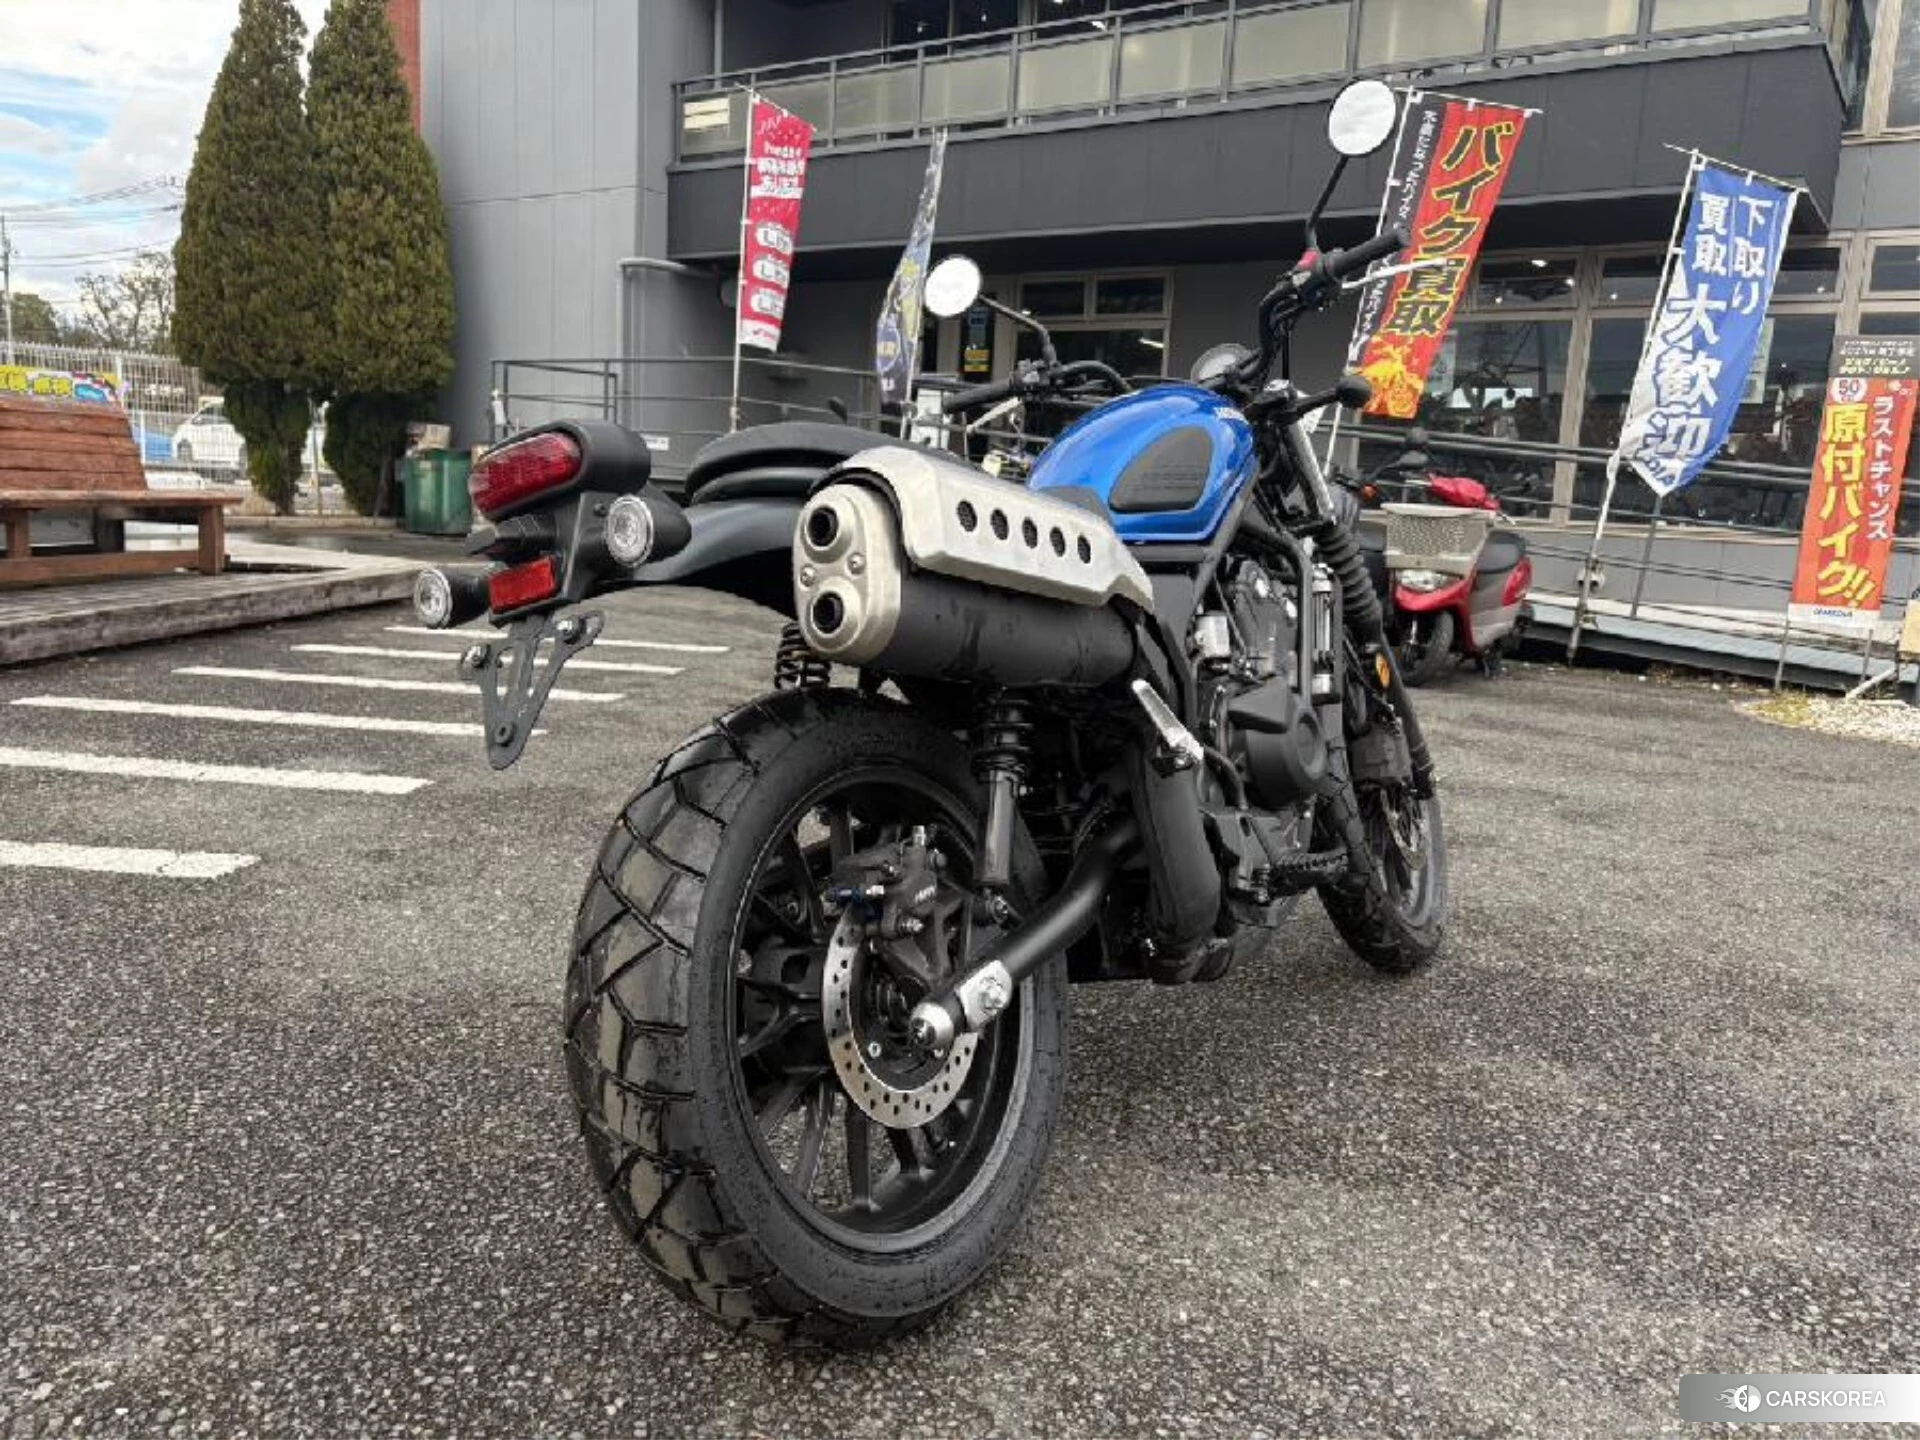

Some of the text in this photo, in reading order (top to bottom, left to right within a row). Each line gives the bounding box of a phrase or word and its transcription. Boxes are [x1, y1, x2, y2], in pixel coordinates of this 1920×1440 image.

[1382, 121, 1516, 337] バイク買取
[1691, 191, 1730, 277] 買取
[1731, 197, 1772, 315] 下取り
[1635, 282, 1729, 462] 大歓迎
[1866, 394, 1895, 541] ラストチャンス
